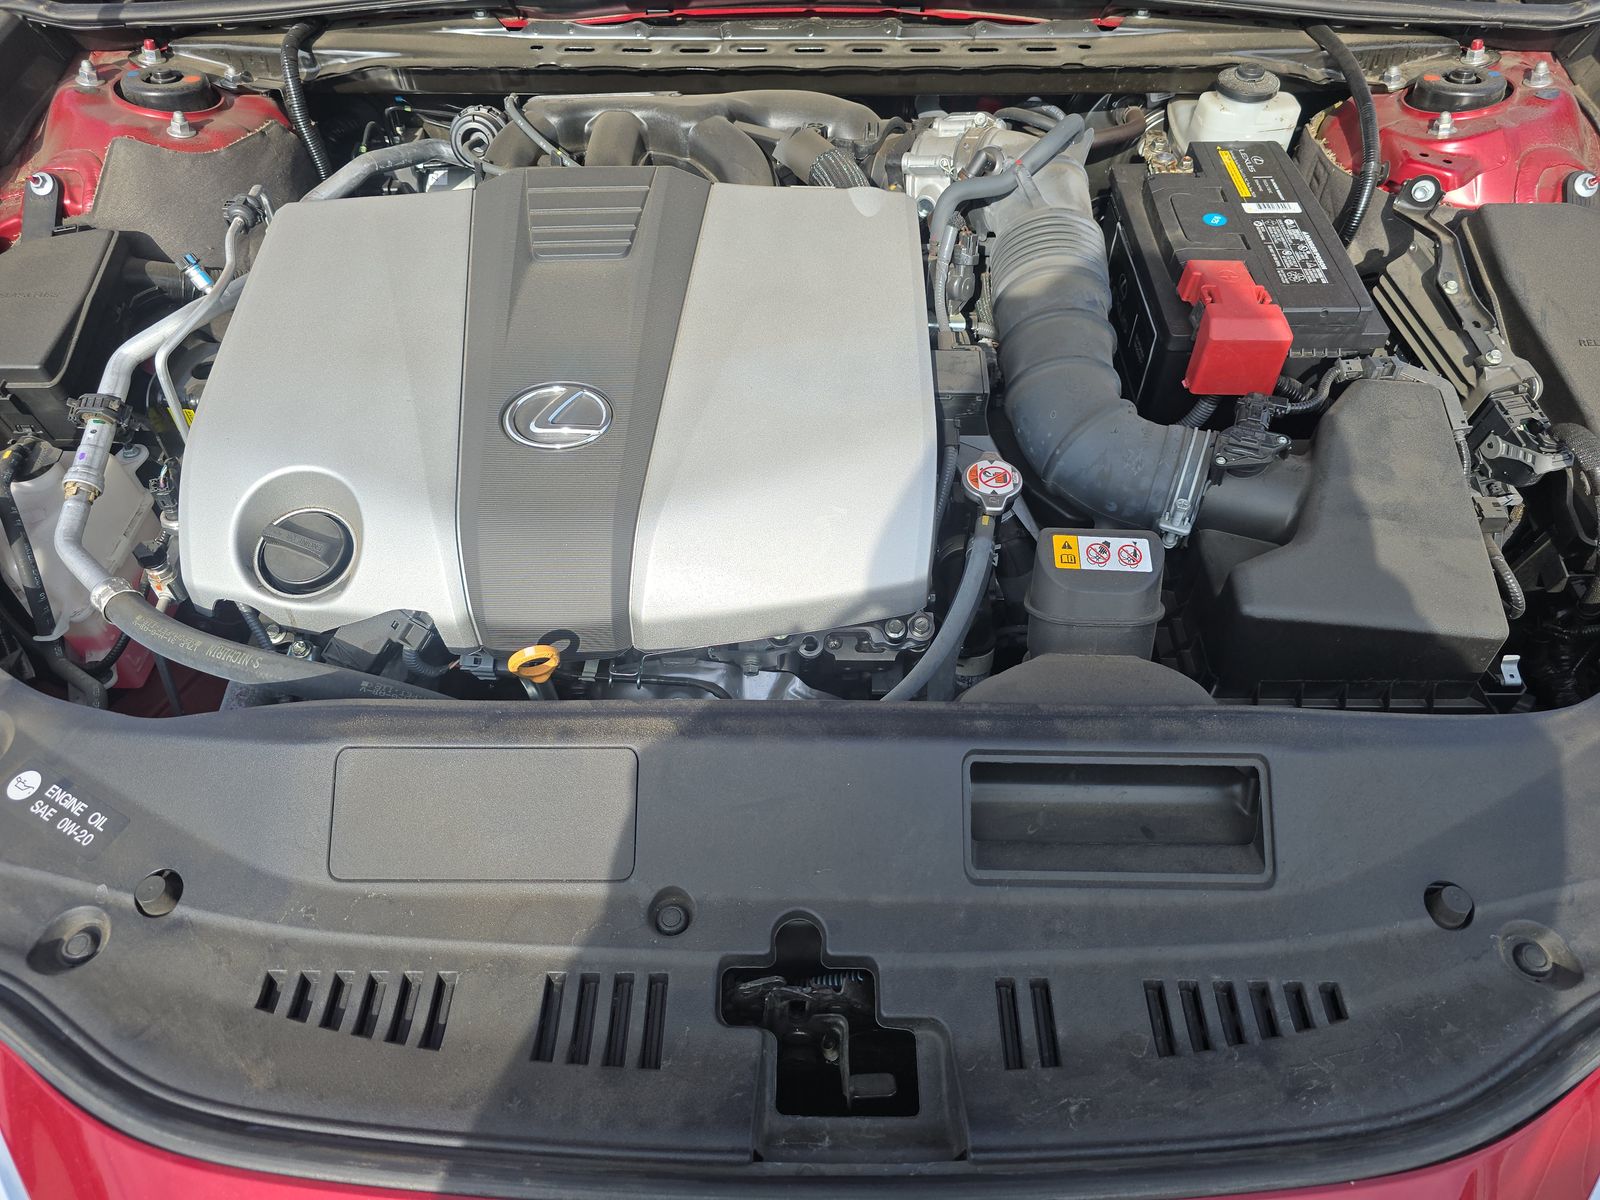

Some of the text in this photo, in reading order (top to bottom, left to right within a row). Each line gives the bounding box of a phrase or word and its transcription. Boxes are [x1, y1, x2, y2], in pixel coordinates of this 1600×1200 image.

[1239, 149, 1256, 172] LEXUS
[29, 799, 95, 846] SAE 0W-20
[44, 784, 108, 832] ENGINE OIL
